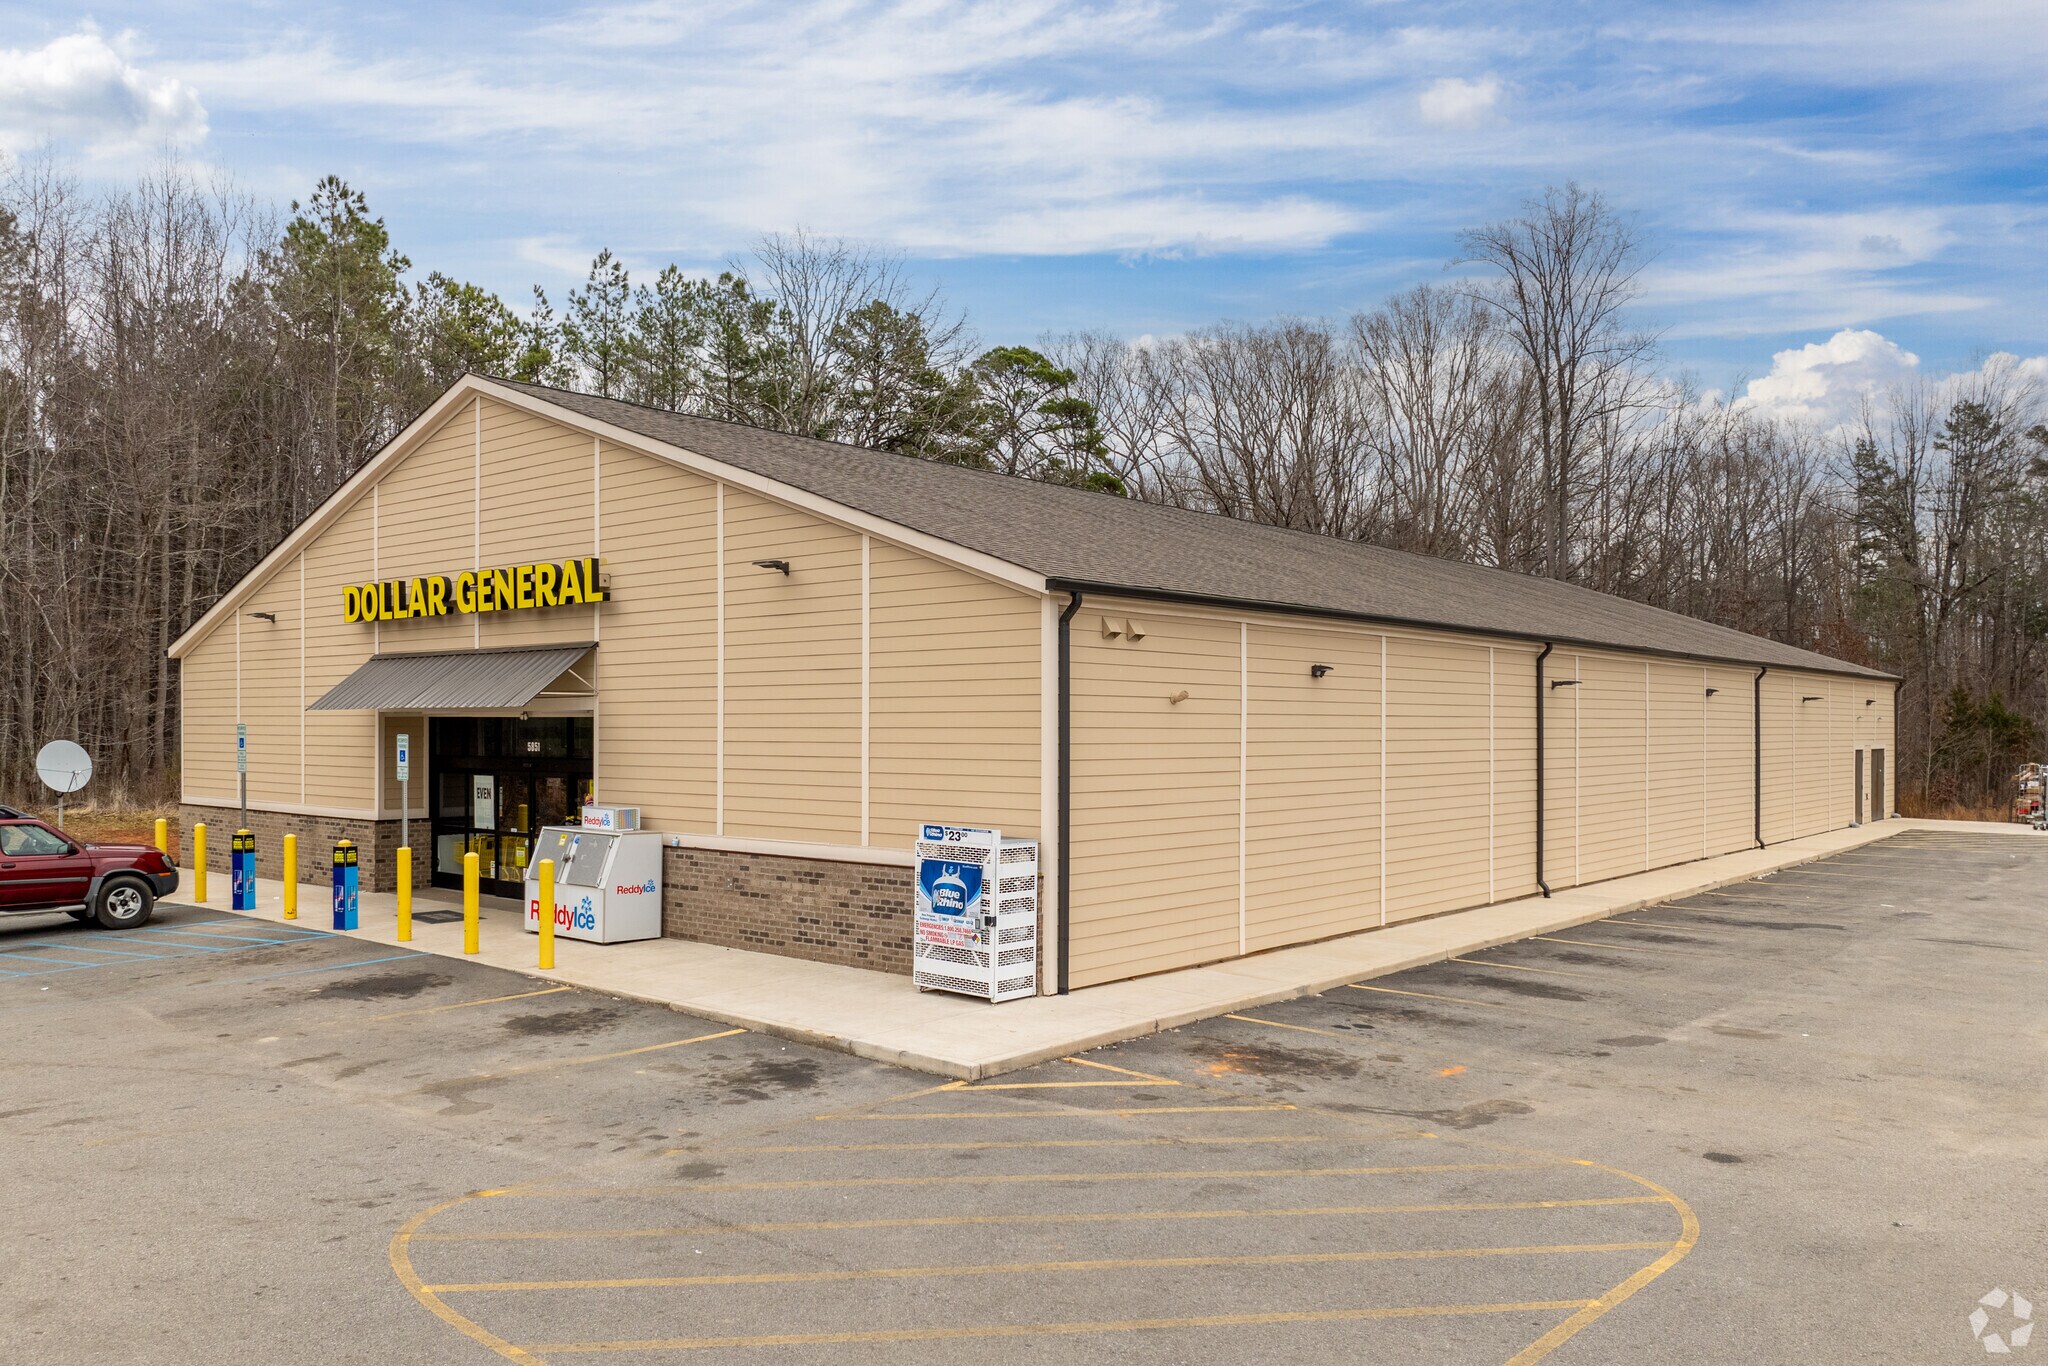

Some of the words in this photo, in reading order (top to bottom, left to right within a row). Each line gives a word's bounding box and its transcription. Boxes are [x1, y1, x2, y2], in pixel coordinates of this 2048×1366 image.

[343, 576, 450, 623] DOLLAR
[456, 558, 606, 614] GENERAL
[527, 741, 541, 752] 5851
[477, 787, 492, 800] EVEN
[617, 883, 656, 895] ReddyIce
[940, 888, 960, 899] Blue
[937, 897, 963, 910] Rhino
[530, 900, 595, 931] RdyIce
